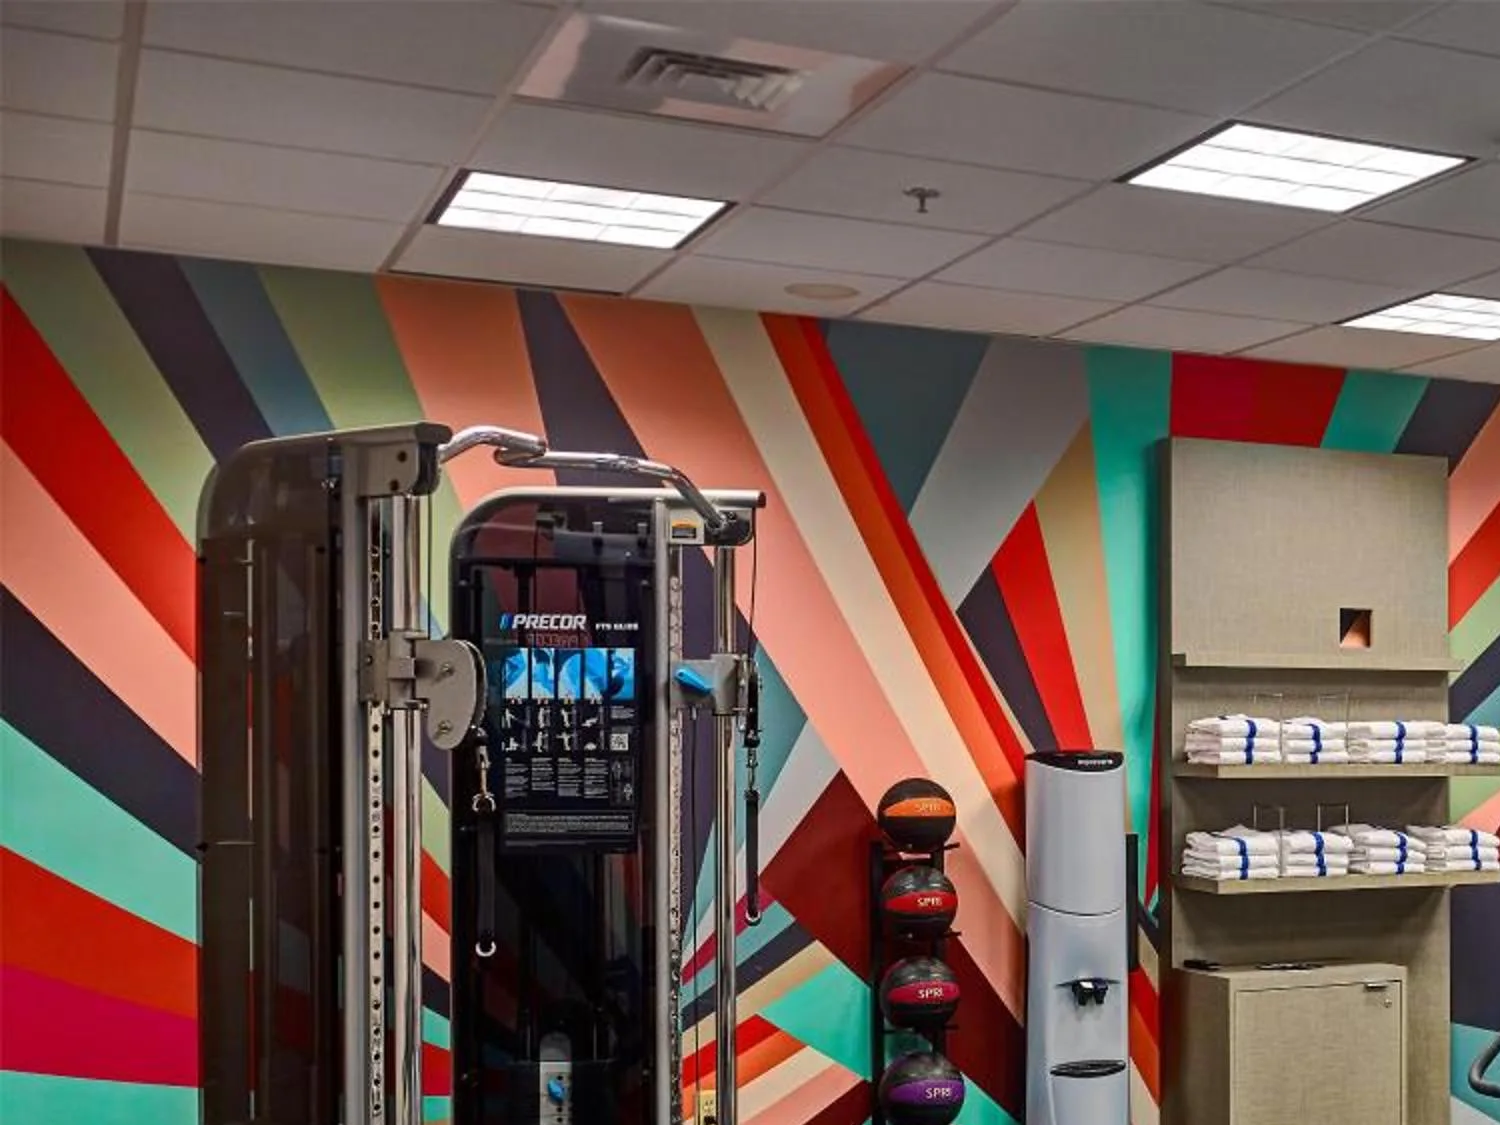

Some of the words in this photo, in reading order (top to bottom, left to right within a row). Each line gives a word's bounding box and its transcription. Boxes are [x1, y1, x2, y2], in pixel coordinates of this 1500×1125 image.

[511, 614, 587, 630] PRECOR
[916, 897, 943, 907] SPRI
[917, 986, 944, 999] SPRI
[924, 1086, 953, 1100] SPRI
